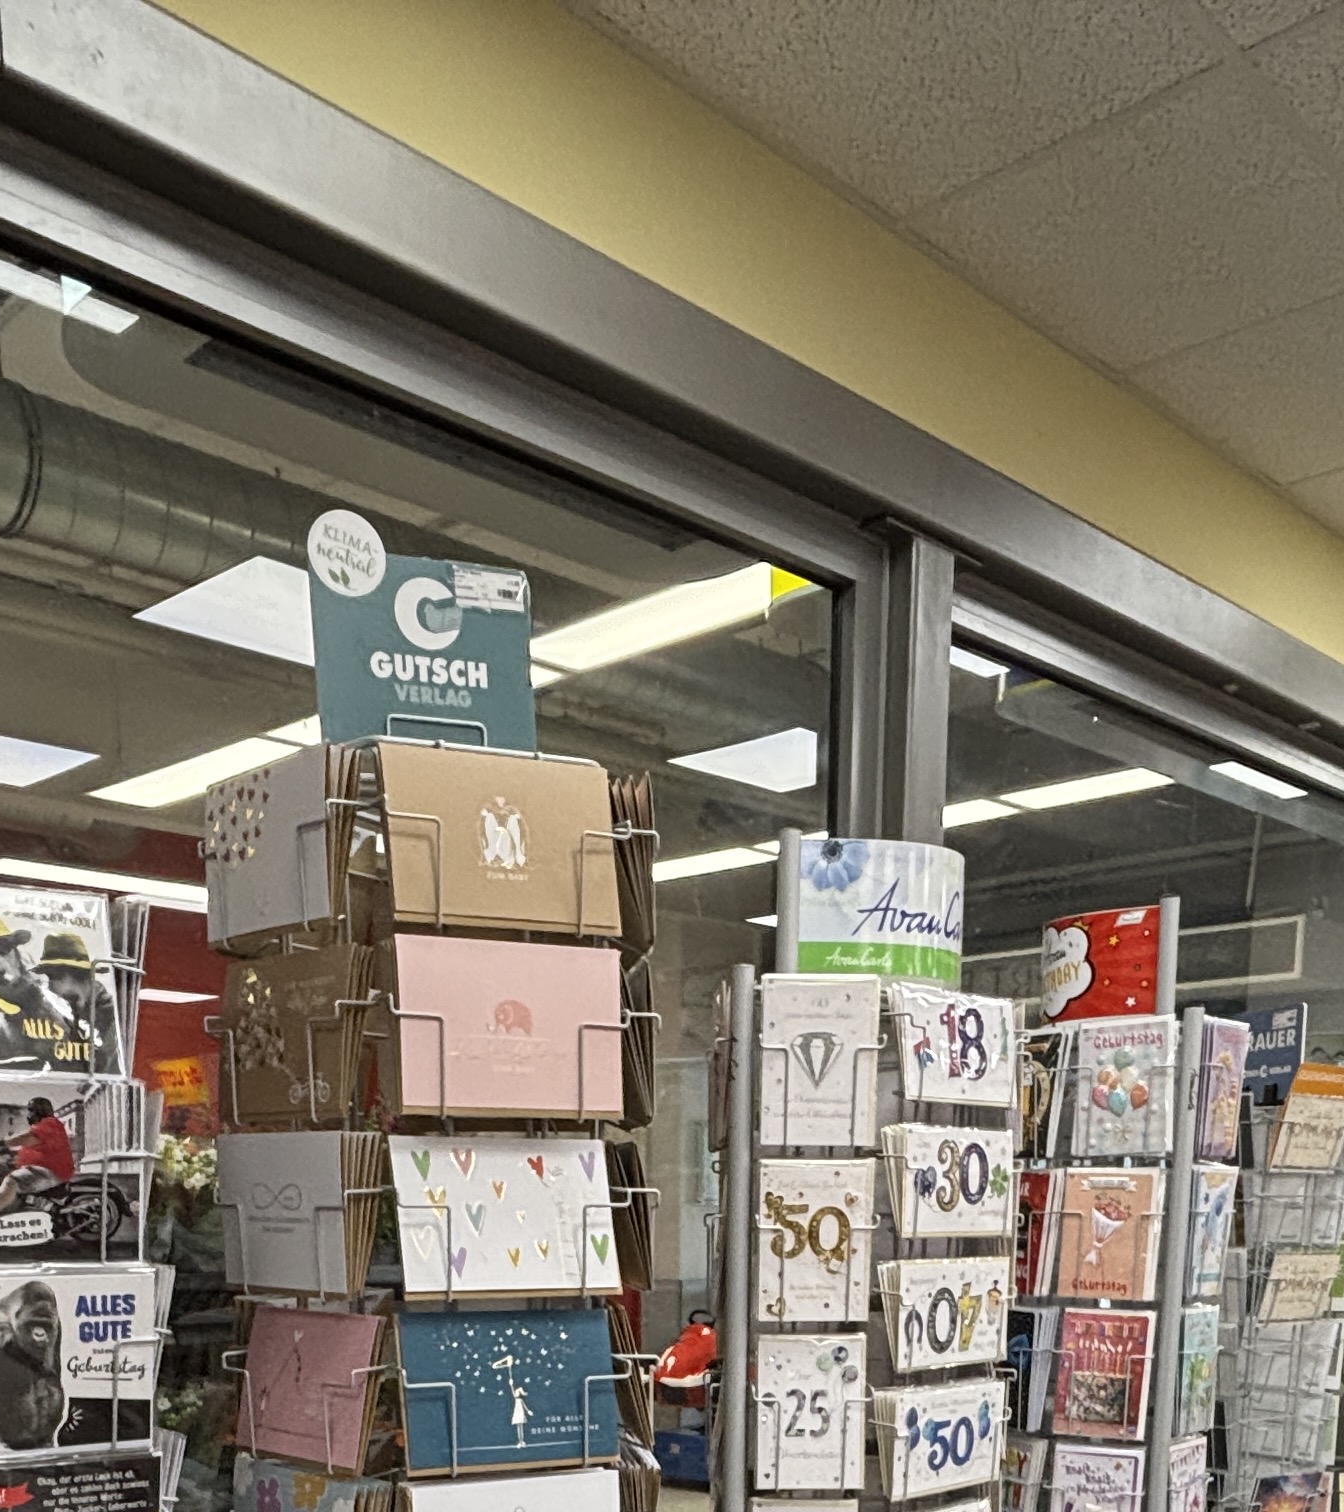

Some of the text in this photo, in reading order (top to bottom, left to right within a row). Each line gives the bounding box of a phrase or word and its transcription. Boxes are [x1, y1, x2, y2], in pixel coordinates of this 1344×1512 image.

[316, 541, 377, 578] neutral
[370, 650, 489, 690] GUTSCH
[393, 683, 472, 708] VERLAG
[22, 1017, 64, 1041] ALLES
[1092, 1031, 1165, 1050] Geburtstag
[939, 1003, 988, 1083] 18
[935, 1138, 990, 1214] 30
[0, 1218, 43, 1231] Lass es
[769, 1203, 852, 1261] 50
[1070, 1277, 1129, 1295] Geburtstag
[74, 1293, 137, 1318] ALLES
[78, 1319, 133, 1345] GUTE
[66, 1355, 147, 1380] Geburtstag
[784, 1388, 832, 1439] 25
[925, 1415, 975, 1472] 50
